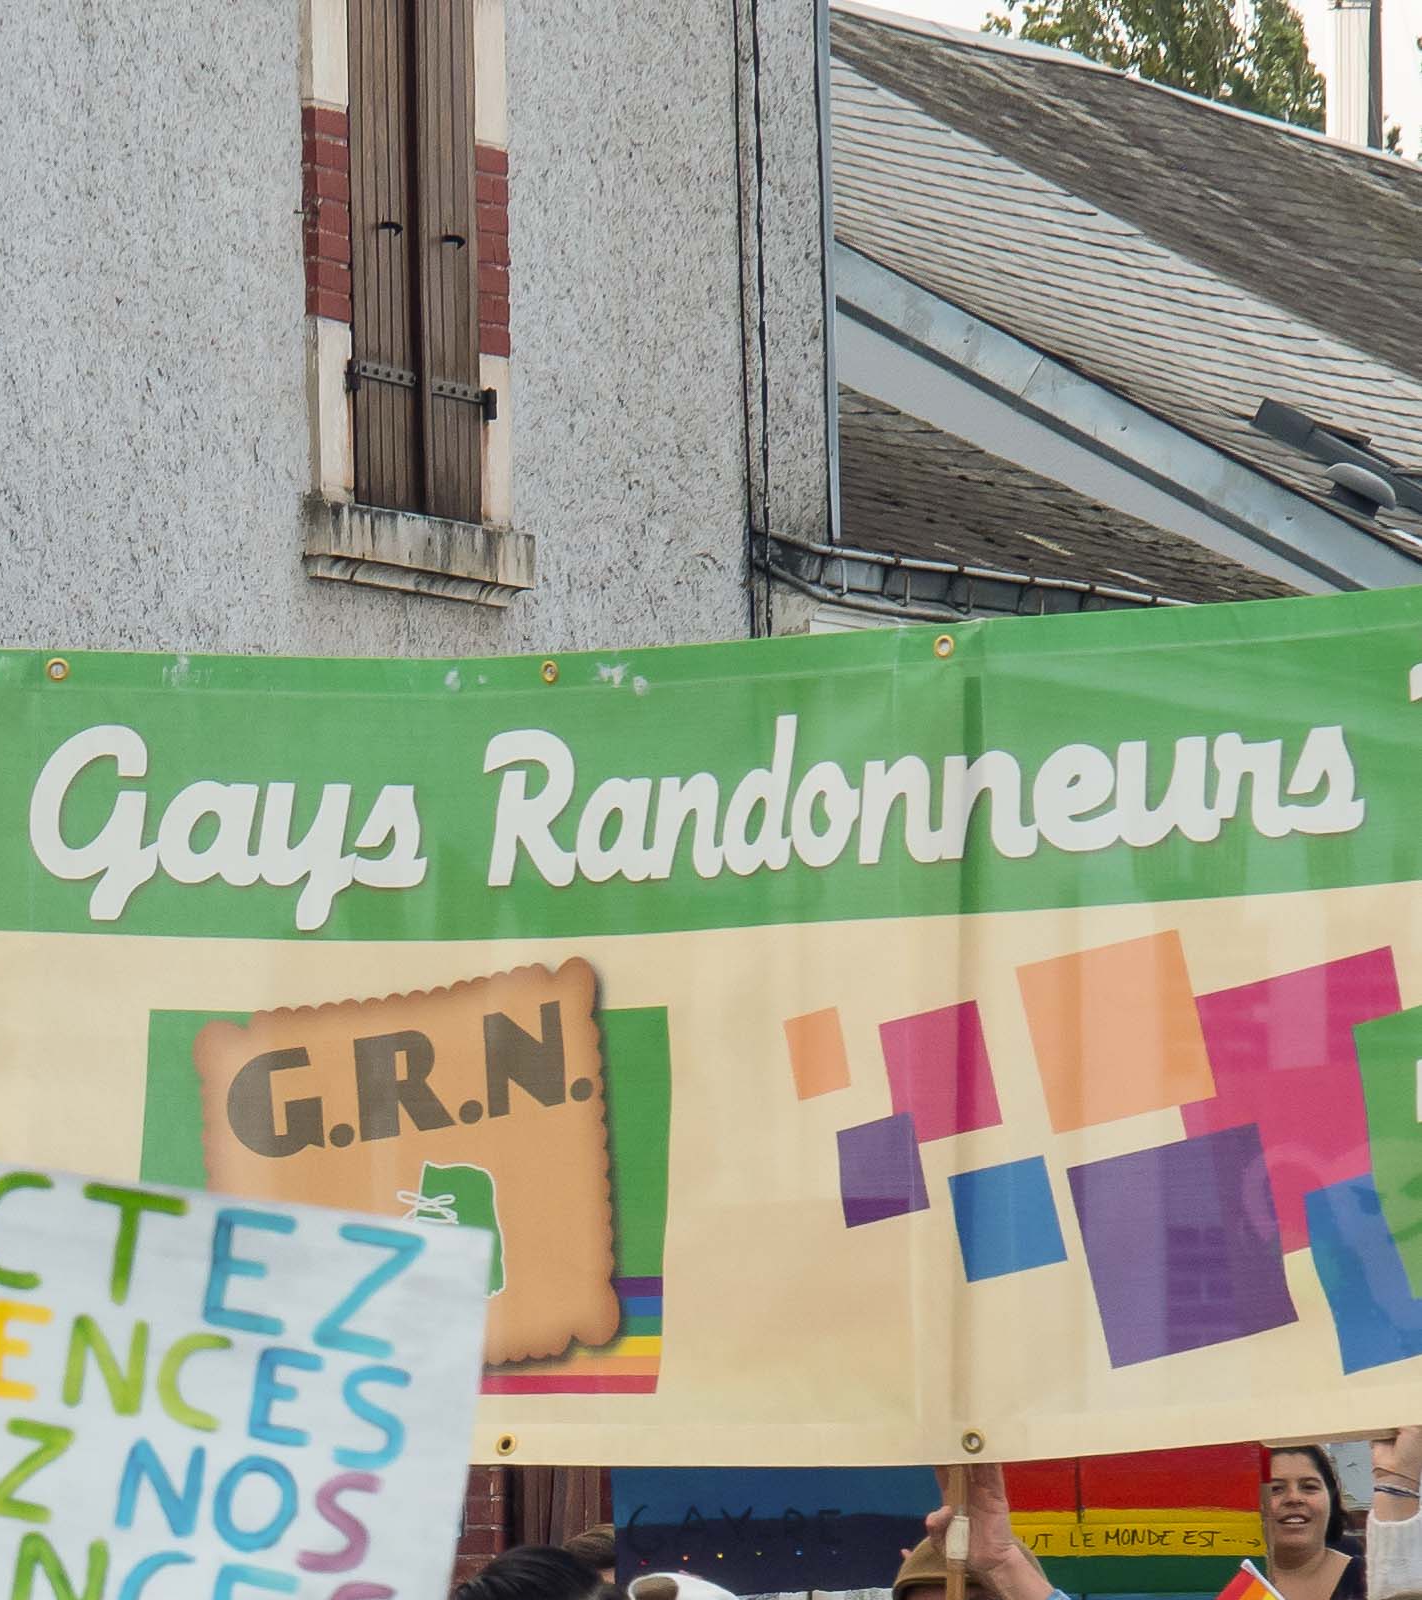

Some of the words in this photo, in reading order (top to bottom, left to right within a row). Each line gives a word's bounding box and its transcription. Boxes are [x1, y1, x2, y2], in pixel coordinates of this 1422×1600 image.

[29, 725, 426, 931] Gays
[487, 714, 1364, 887] Randonneurs
[227, 1000, 594, 1158] G.R.N.
[115, 1438, 383, 1574] NOS
[1070, 1531, 1095, 1547] LE
[1105, 1528, 1175, 1548] MONDE
[1183, 1530, 1221, 1549] EST
